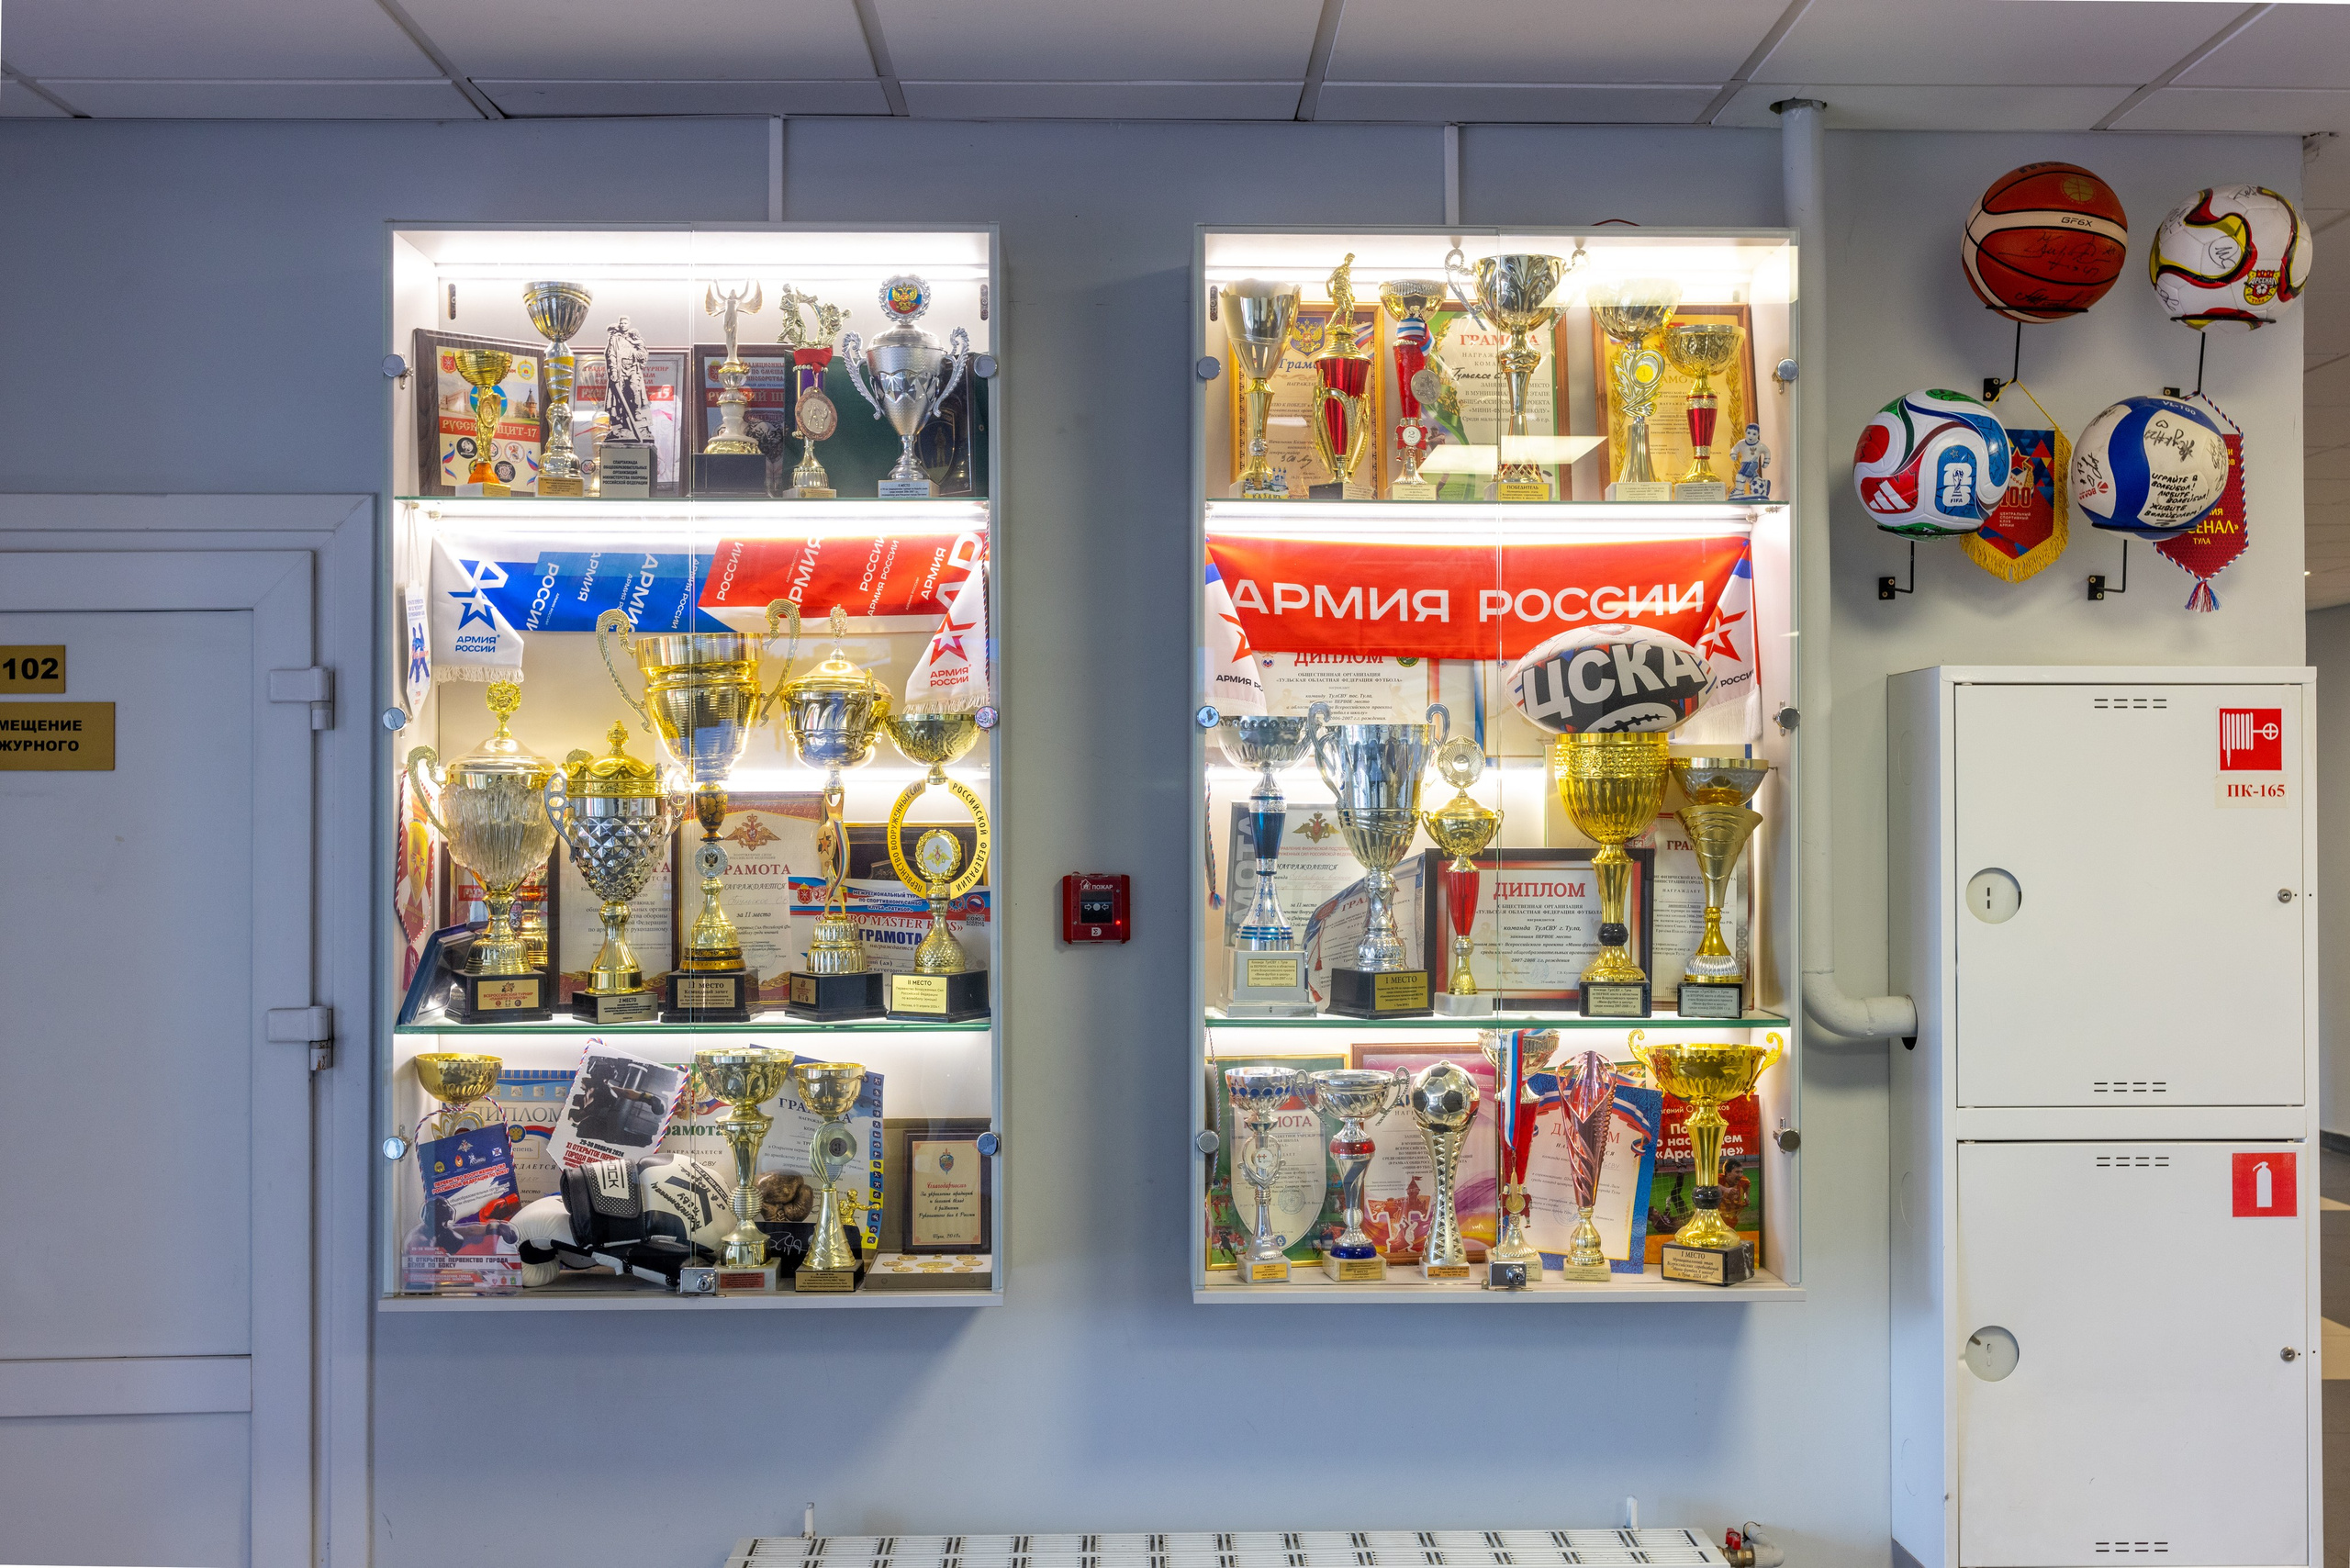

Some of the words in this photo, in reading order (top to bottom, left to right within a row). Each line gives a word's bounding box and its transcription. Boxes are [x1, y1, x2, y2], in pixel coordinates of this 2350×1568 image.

[2061, 217, 2093, 227] GF6X
[2162, 400, 2197, 416] VL-100
[442, 420, 477, 431] РУССК
[1407, 431, 1416, 439] 2
[2151, 480, 2196, 491] ВОЛЕЙБОЛ!
[2152, 473, 2188, 484] ИГРАЙТЕ
[2150, 503, 2188, 511] ЖИВИТЕ
[717, 542, 744, 601] РОССИИ
[788, 536, 825, 609] РМИЯ
[867, 582, 886, 617] АРМИЯ
[880, 540, 900, 580] РОССИИ
[921, 547, 946, 600] АРМИЯ
[1231, 578, 1449, 623] АРМИЯ
[1479, 580, 1704, 623] РОССИИ
[671, 593, 689, 631] РОССИИ
[456, 635, 497, 644] АРМИЯ
[455, 644, 496, 653] РОССИИ
[3, 657, 59, 679] 102
[930, 667, 969, 678] АРМИЯ
[930, 676, 969, 688] РОССИИ
[1215, 675, 1252, 686] АРМИЯ
[1523, 644, 1706, 720] ЦСКА
[910, 782, 923, 795] СИЛ
[2227, 784, 2286, 798] ПК-165
[952, 783, 989, 835] РОССИЙСКОЙ
[890, 792, 912, 850] ВООРУЖЕННЫХ
[723, 864, 791, 875] РАМОТА
[892, 852, 923, 892] ПЕРВЕНСТВО
[956, 842, 988, 892] ФЕДЕРАЦИИ
[1494, 883, 1585, 900] ДИПЛОМ
[869, 918, 923, 929] MASTER
[859, 929, 923, 945] ГРАМОТА
[664, 1123, 722, 1138] рамота
[565, 1150, 587, 1161] ГОРОДА
[572, 1143, 600, 1159] ОТКРЫТОЕ
[594, 1142, 612, 1154] НОЯБРЯ
[612, 1148, 625, 1158] 2024
[432, 1182, 463, 1194] РОССИЙСКОЙ
[463, 1175, 488, 1186] ФЕДЕРАЦИИ
[496, 1168, 509, 1176] БОКСУ
[434, 1175, 463, 1187] ПЕРВЕНСТВО
[464, 1166, 496, 1180] ВООРУЖЕННЫХ
